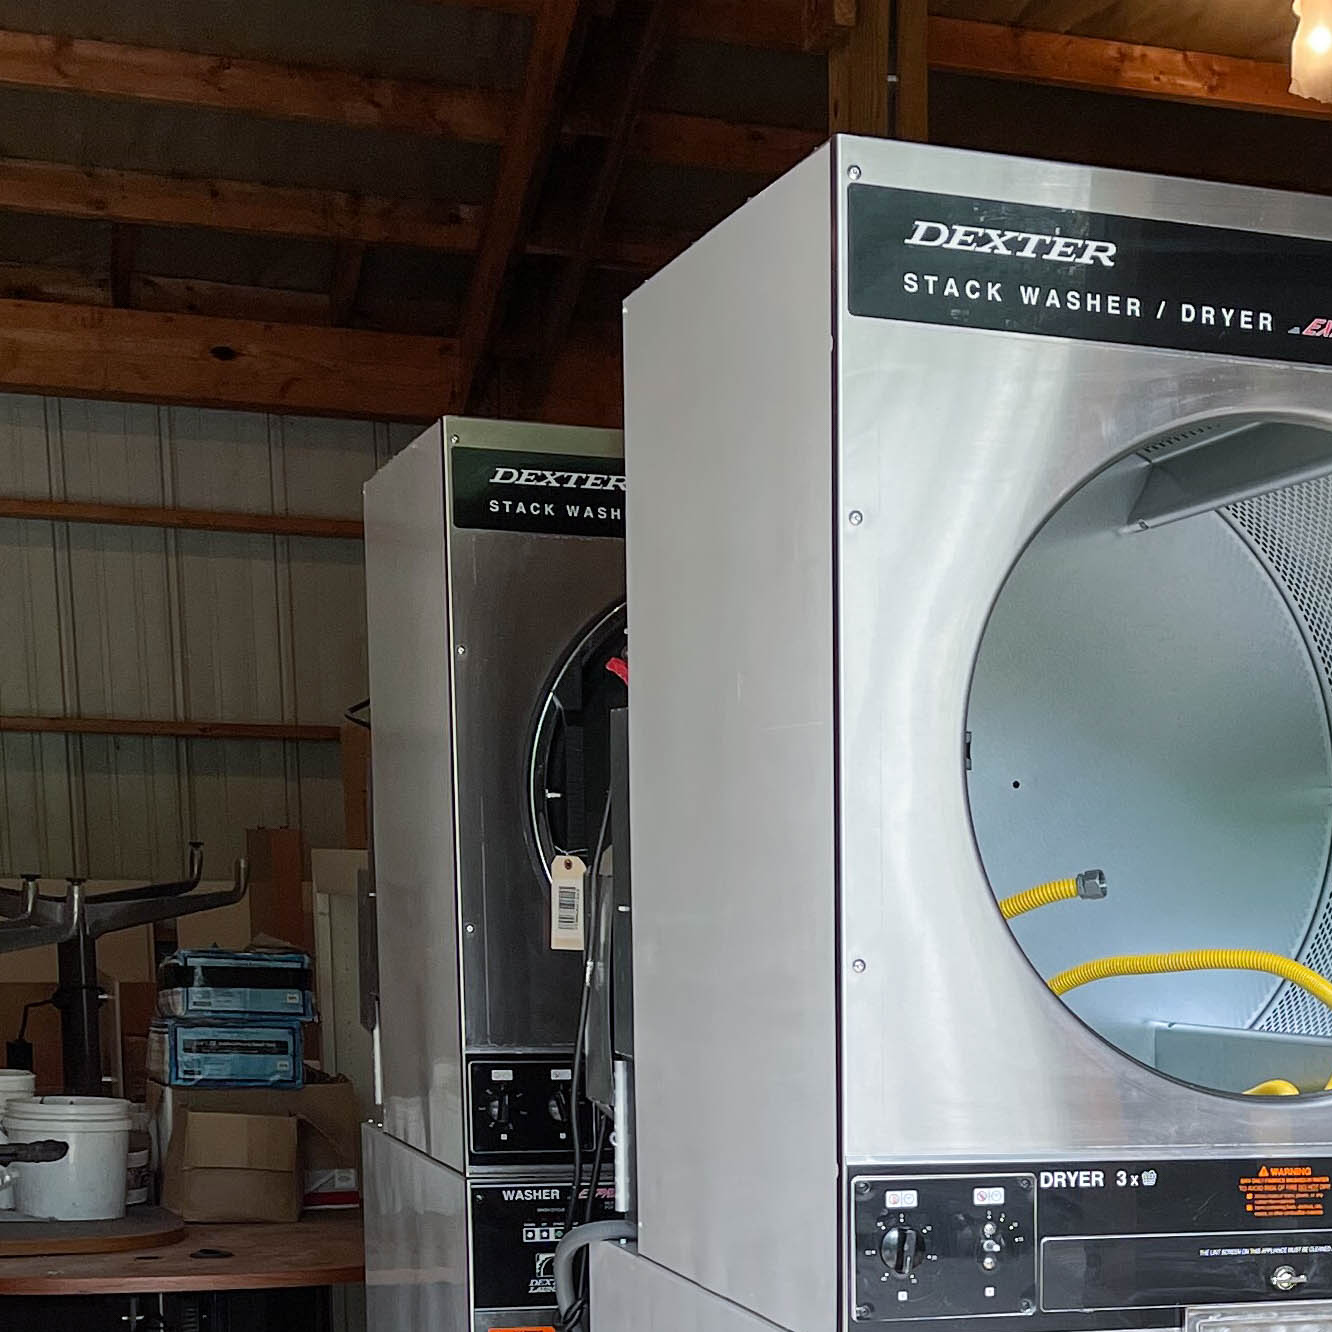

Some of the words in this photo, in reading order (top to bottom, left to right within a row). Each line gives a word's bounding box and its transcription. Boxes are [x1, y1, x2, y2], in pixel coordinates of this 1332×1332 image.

[904, 219, 1118, 267] DEXTER
[903, 272, 1003, 302] STACK
[1019, 285, 1142, 318] WASHER
[1155, 300, 1167, 320] /
[1181, 304, 1273, 332] DRYER
[489, 467, 627, 491] DEXTER
[489, 500, 555, 516] STACK
[566, 504, 621, 520] WASH
[1040, 1171, 1104, 1188] DRYER
[1116, 1170, 1127, 1186] 3
[1130, 1174, 1139, 1186] x
[1270, 1167, 1312, 1176] WARNING
[502, 1189, 560, 1200] WASHER
